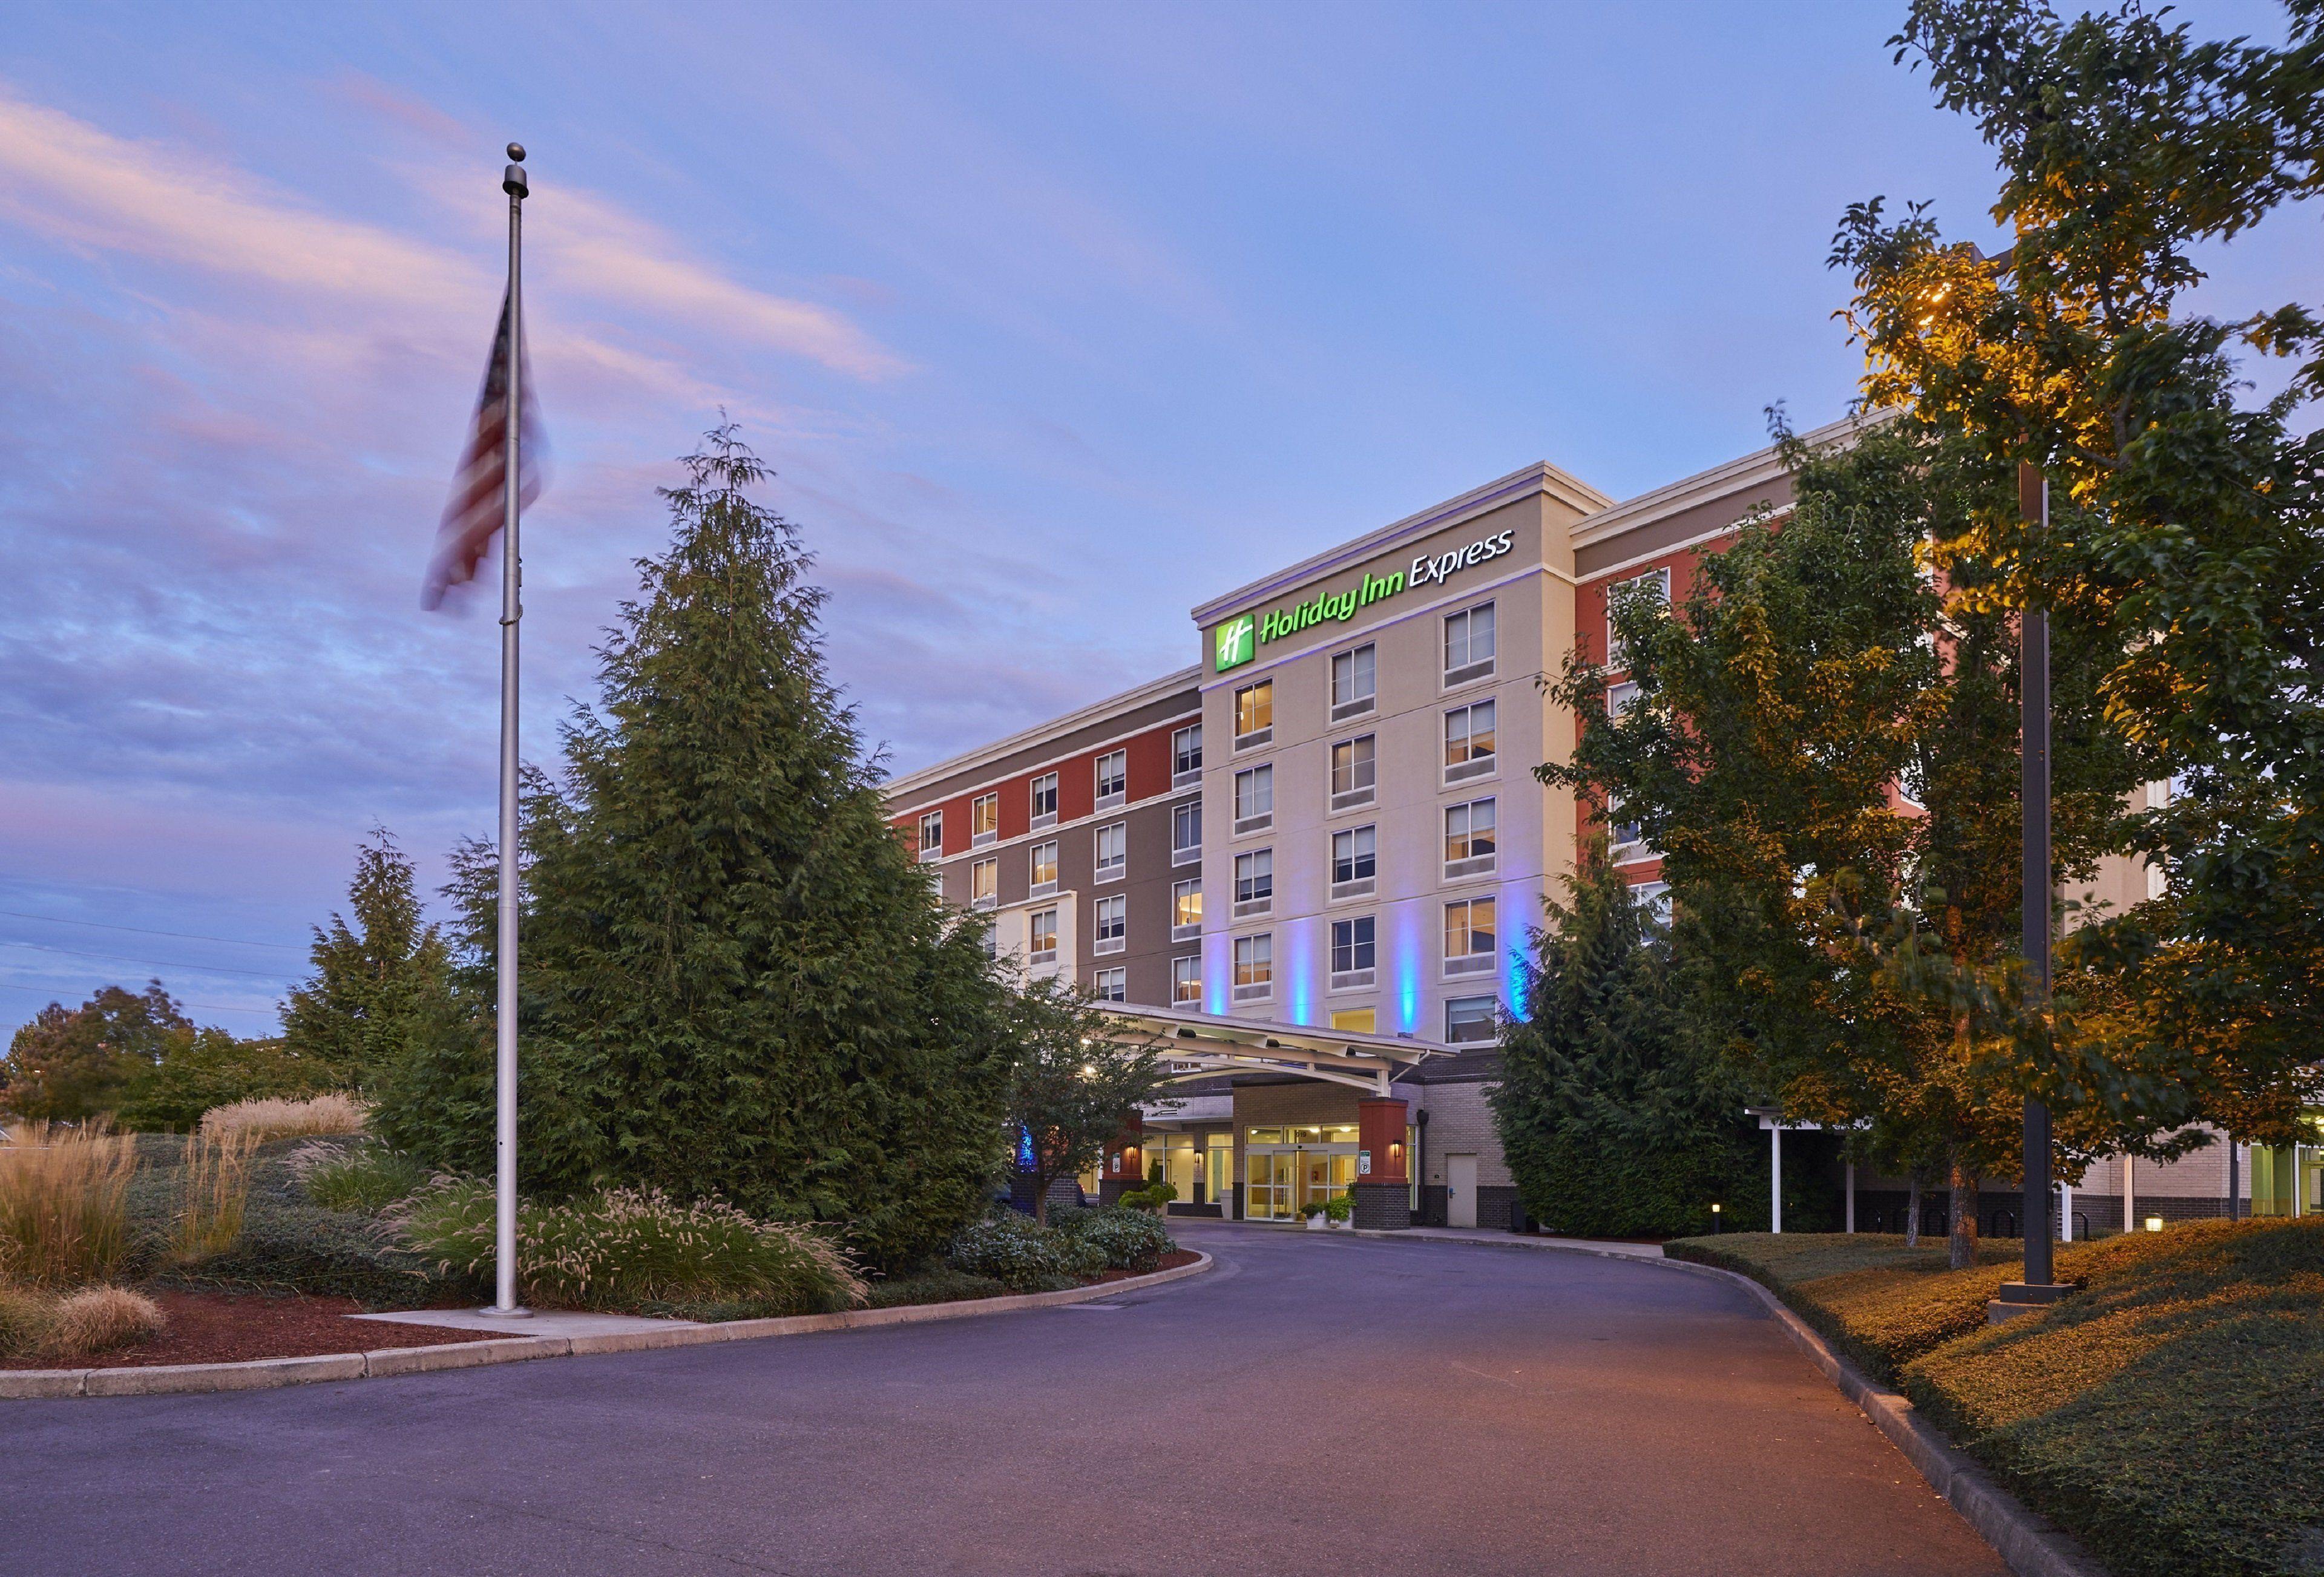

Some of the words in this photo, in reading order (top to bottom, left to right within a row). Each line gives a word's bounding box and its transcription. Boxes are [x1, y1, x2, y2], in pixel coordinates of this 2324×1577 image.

[1259, 589, 1359, 643] Holiday
[1361, 571, 1405, 606] Inn
[1409, 529, 1514, 587] Express
